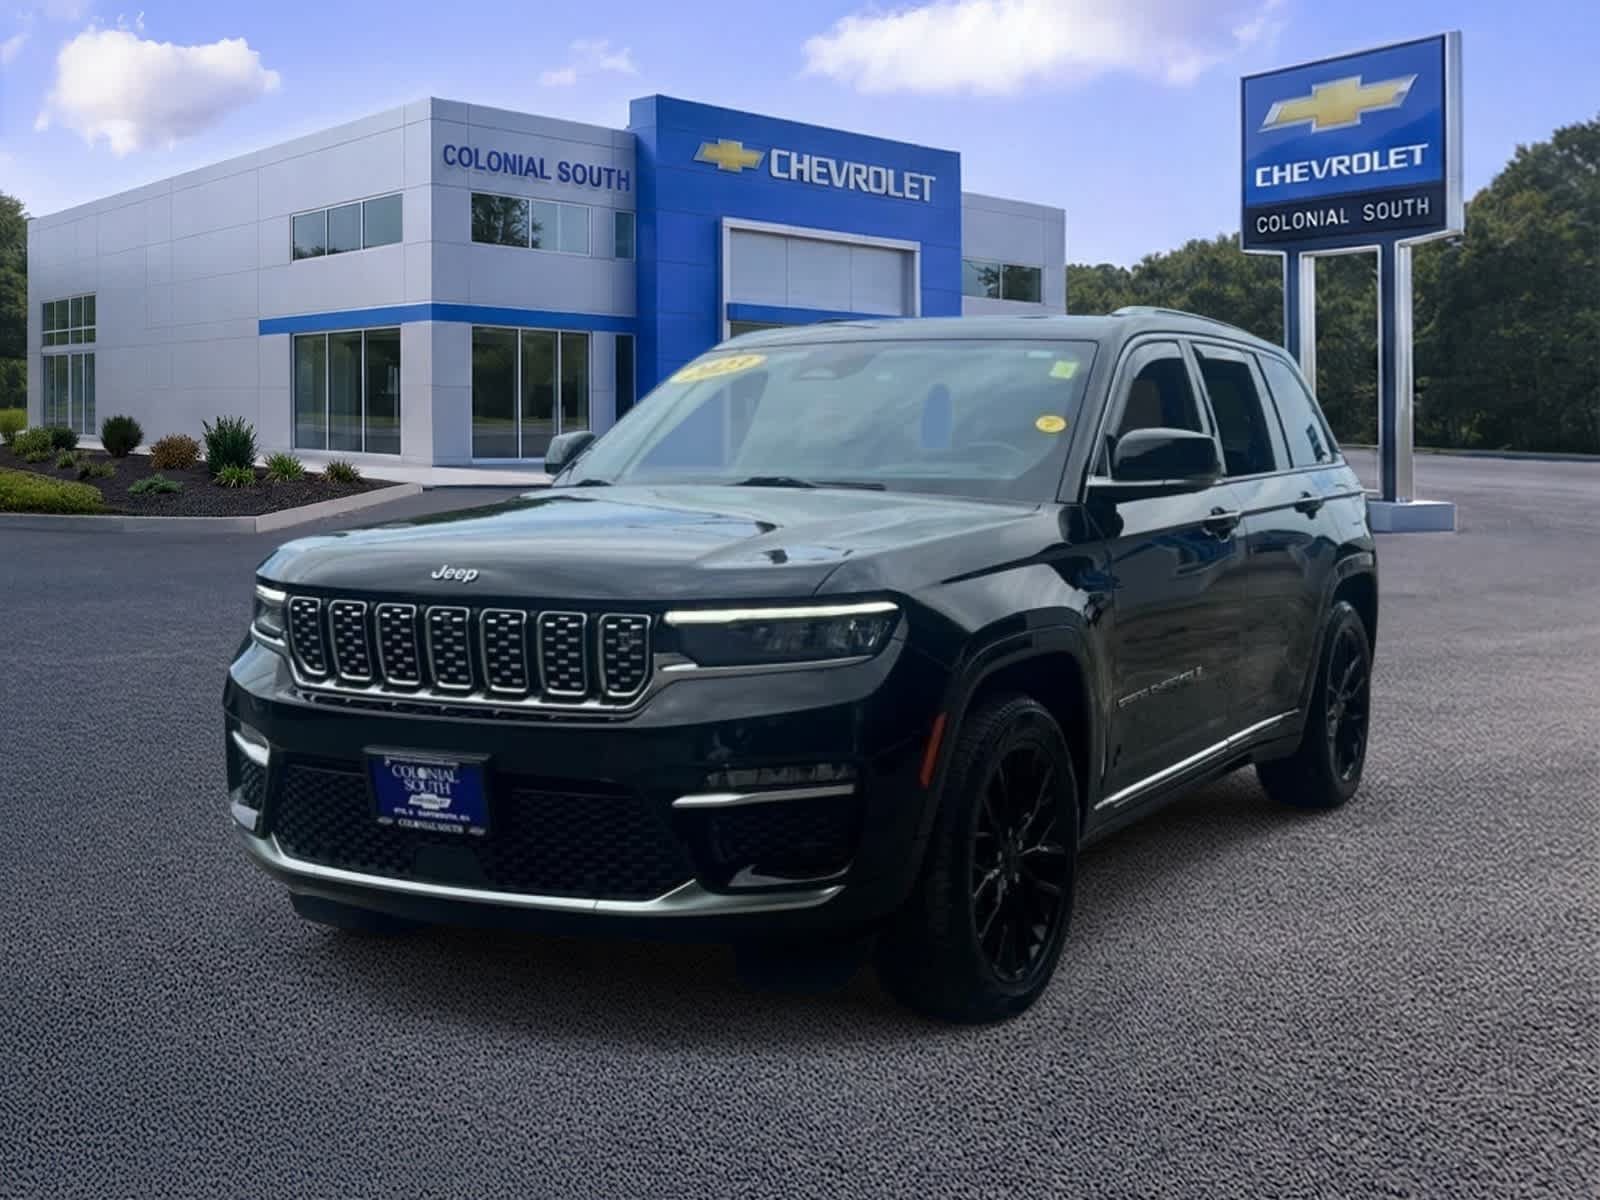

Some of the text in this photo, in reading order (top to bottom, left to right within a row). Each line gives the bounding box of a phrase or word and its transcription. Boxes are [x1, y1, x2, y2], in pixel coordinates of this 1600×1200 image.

[443, 144, 630, 192] COLONIAL SOUTH
[768, 148, 936, 202] CHEVROLET
[1255, 143, 1429, 187] CHEVROLET
[1256, 197, 1429, 234] COLONIAL SOUTH
[431, 564, 478, 582] Jeep
[391, 764, 455, 783] COLONIAL
[404, 779, 451, 795] SOUTH
